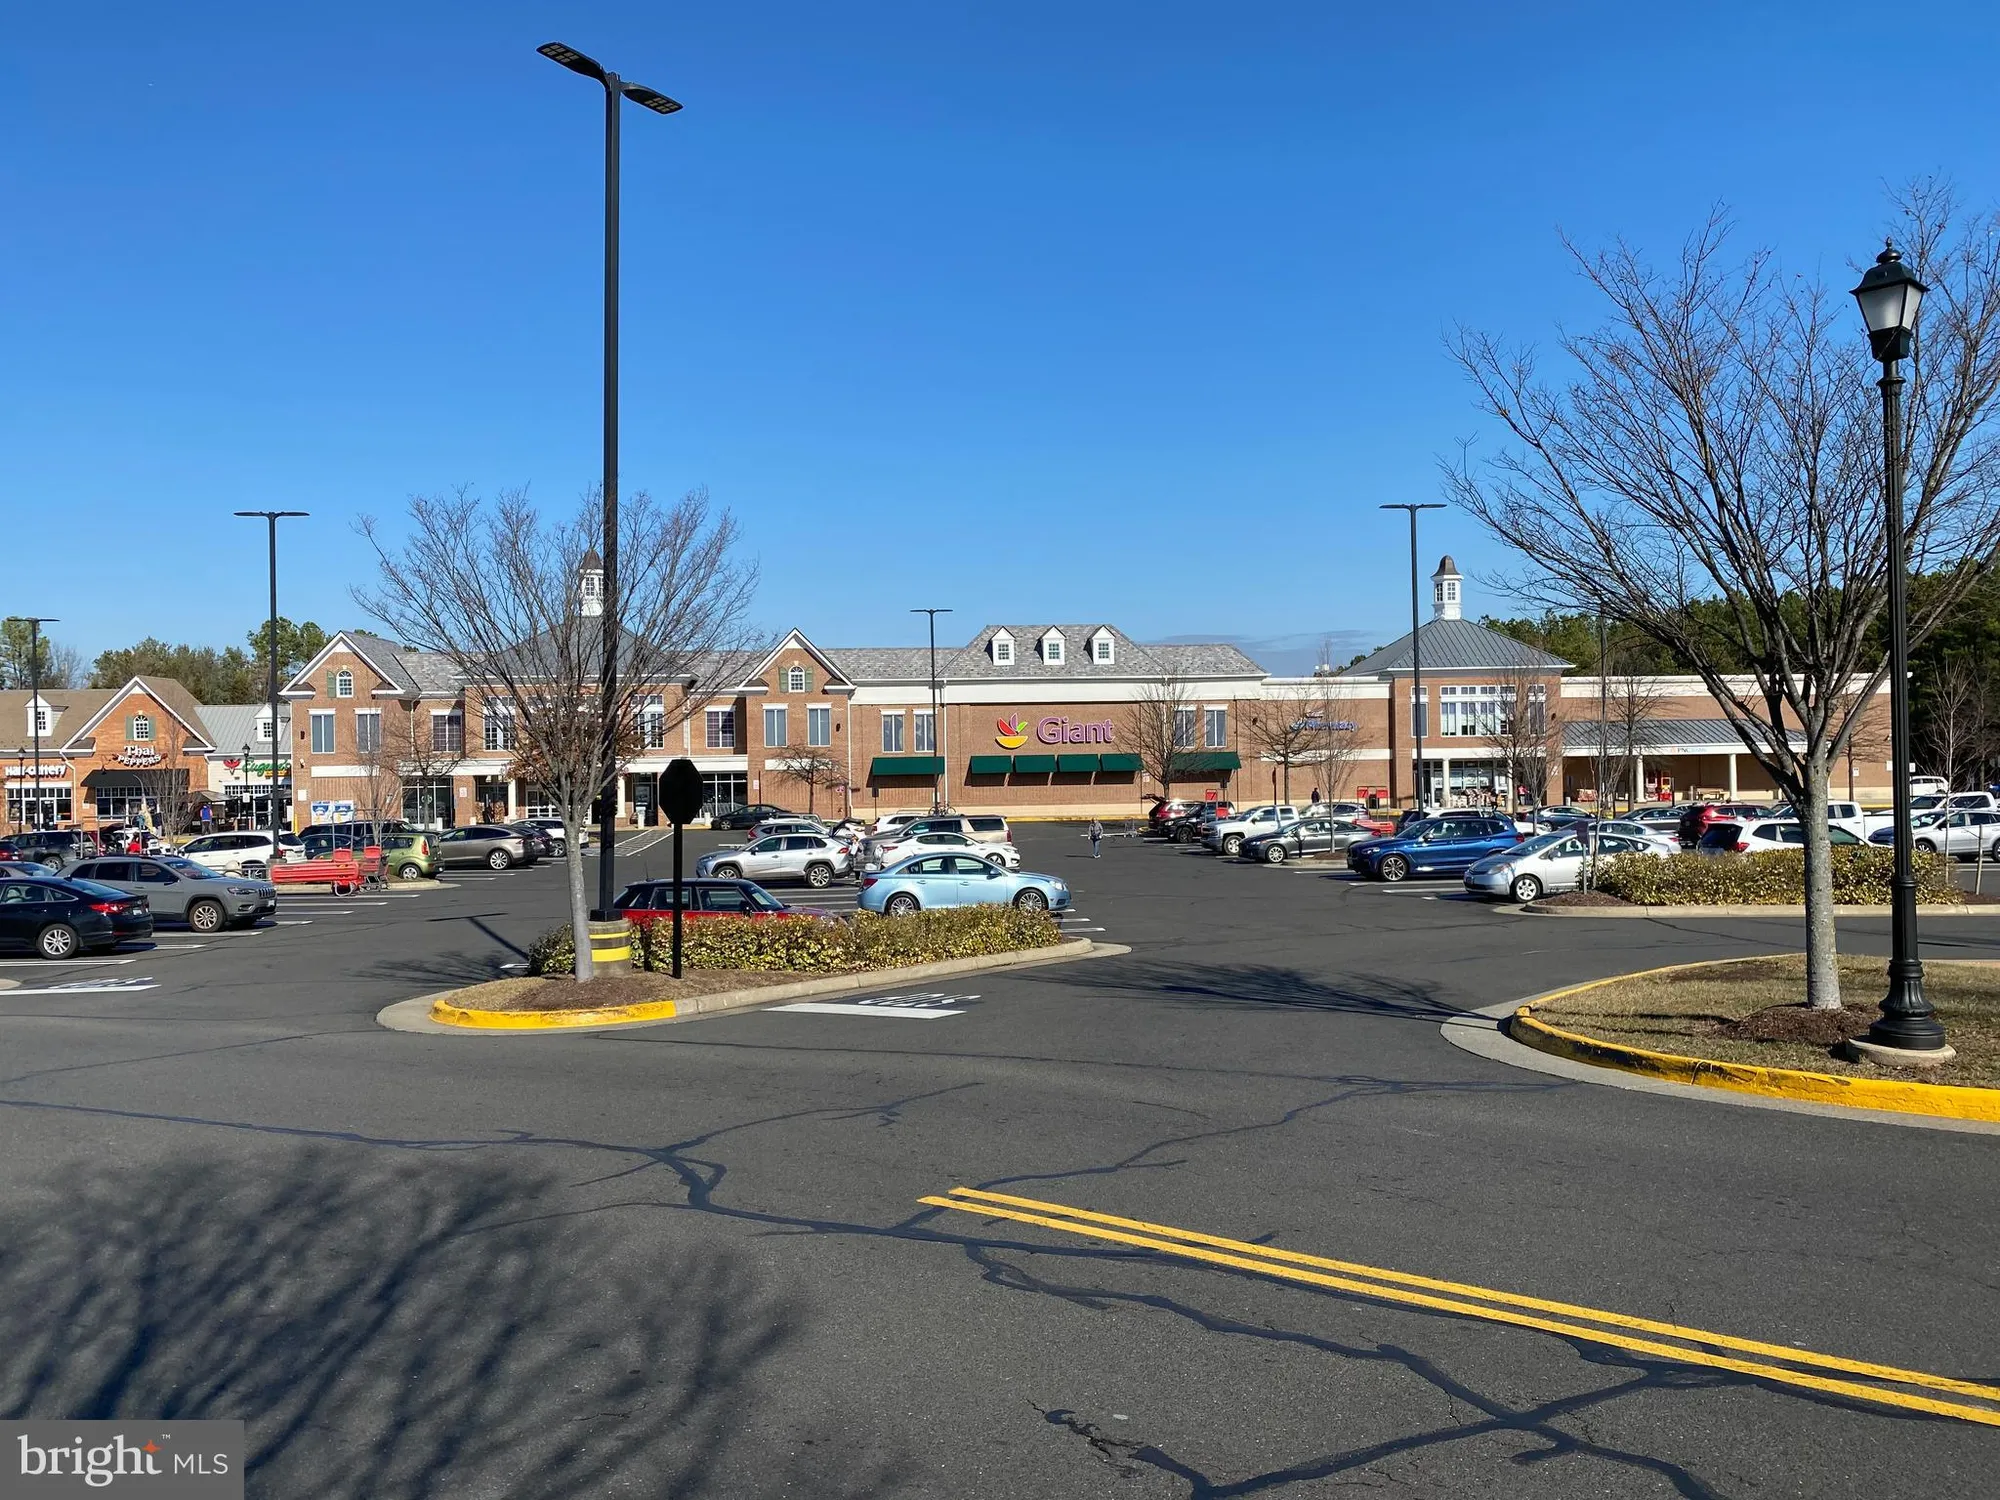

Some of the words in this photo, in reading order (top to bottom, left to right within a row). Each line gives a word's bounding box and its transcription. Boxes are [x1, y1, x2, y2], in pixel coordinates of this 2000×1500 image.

[1037, 716, 1116, 744] Giant
[123, 745, 155, 756] Thai
[117, 754, 162, 766] PEPPERS
